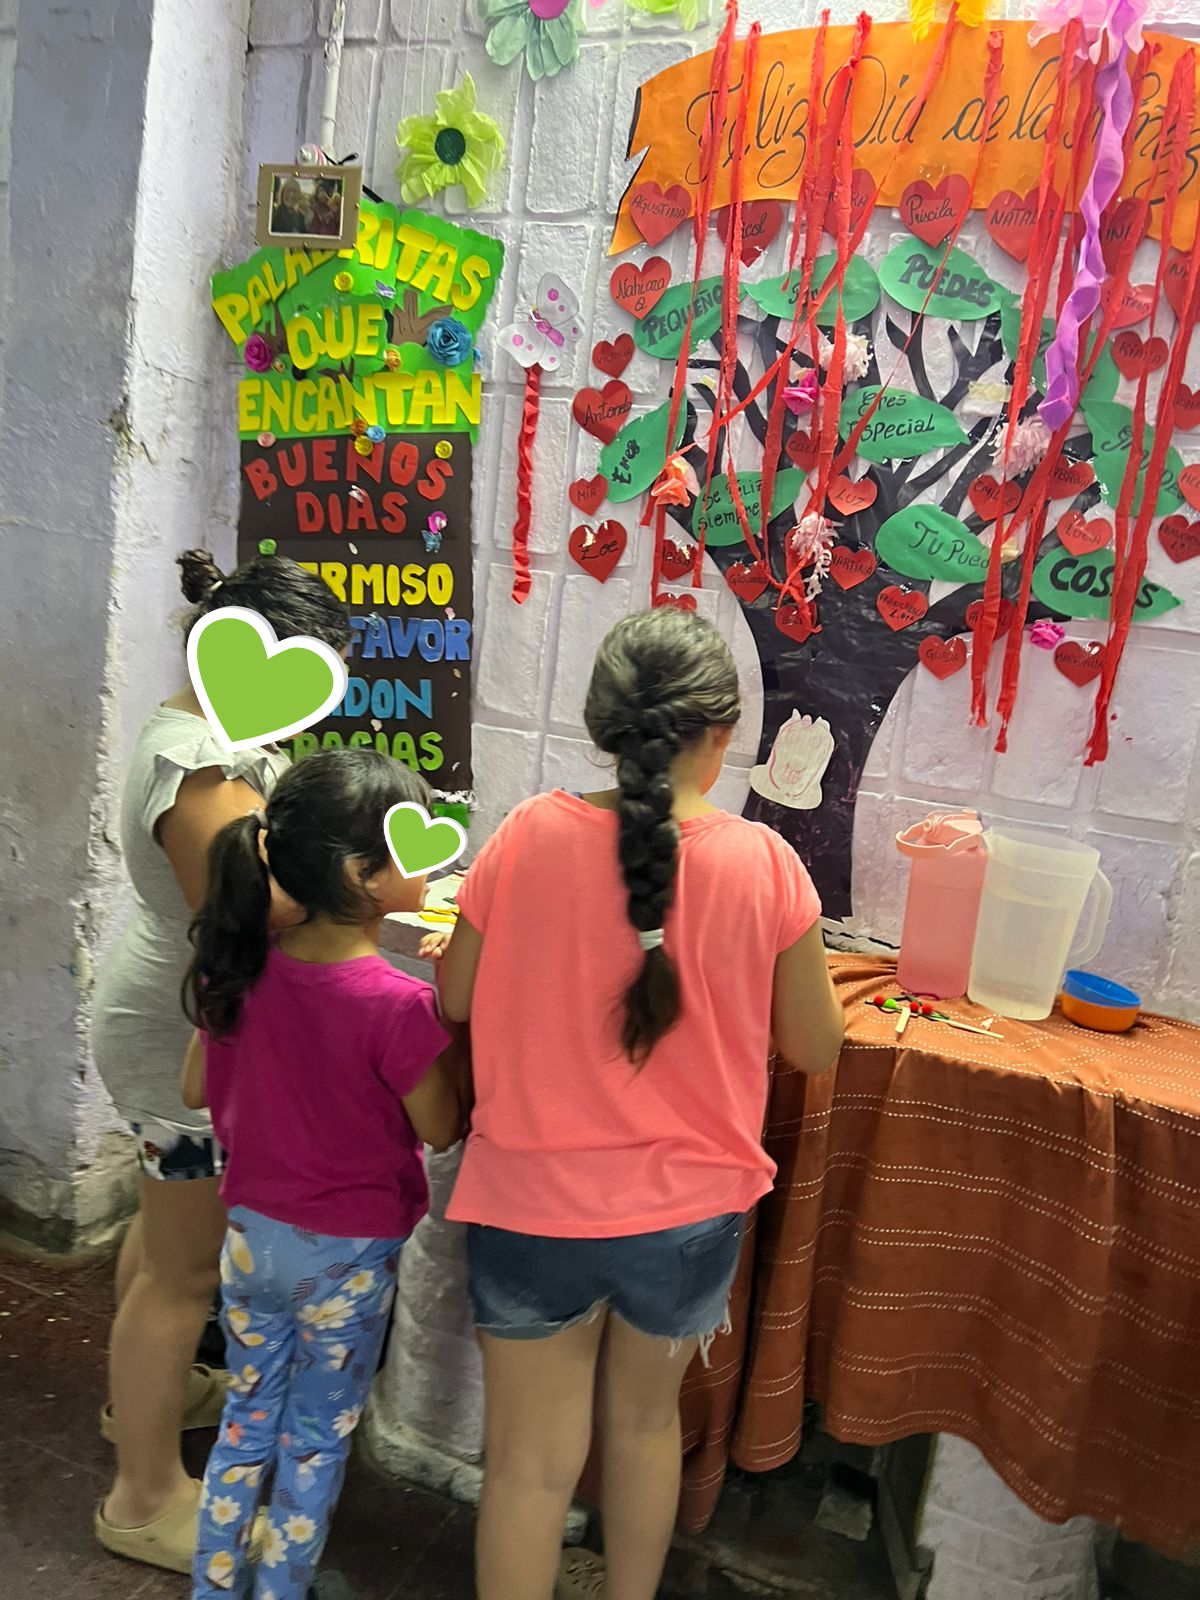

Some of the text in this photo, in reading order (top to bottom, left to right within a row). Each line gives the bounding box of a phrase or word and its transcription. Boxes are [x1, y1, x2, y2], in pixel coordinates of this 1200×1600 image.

[740, 212, 768, 239] icol
[905, 194, 957, 226] Priscila
[212, 210, 491, 346] PALARITAS
[616, 274, 665, 300] Nahiara
[898, 253, 996, 309] PUEDES
[286, 303, 383, 371] QUE
[641, 284, 723, 347] PEQUEÑO
[239, 370, 481, 432] ENCANTAN
[857, 391, 908, 416] Eres
[244, 439, 454, 501] BUENOS
[296, 491, 408, 535] DIAS
[834, 488, 867, 508] LUZ
[298, 562, 454, 606] RMISO
[1050, 558, 1160, 608] COSS
[346, 615, 472, 663] FAVOR
[327, 677, 433, 720] DON
